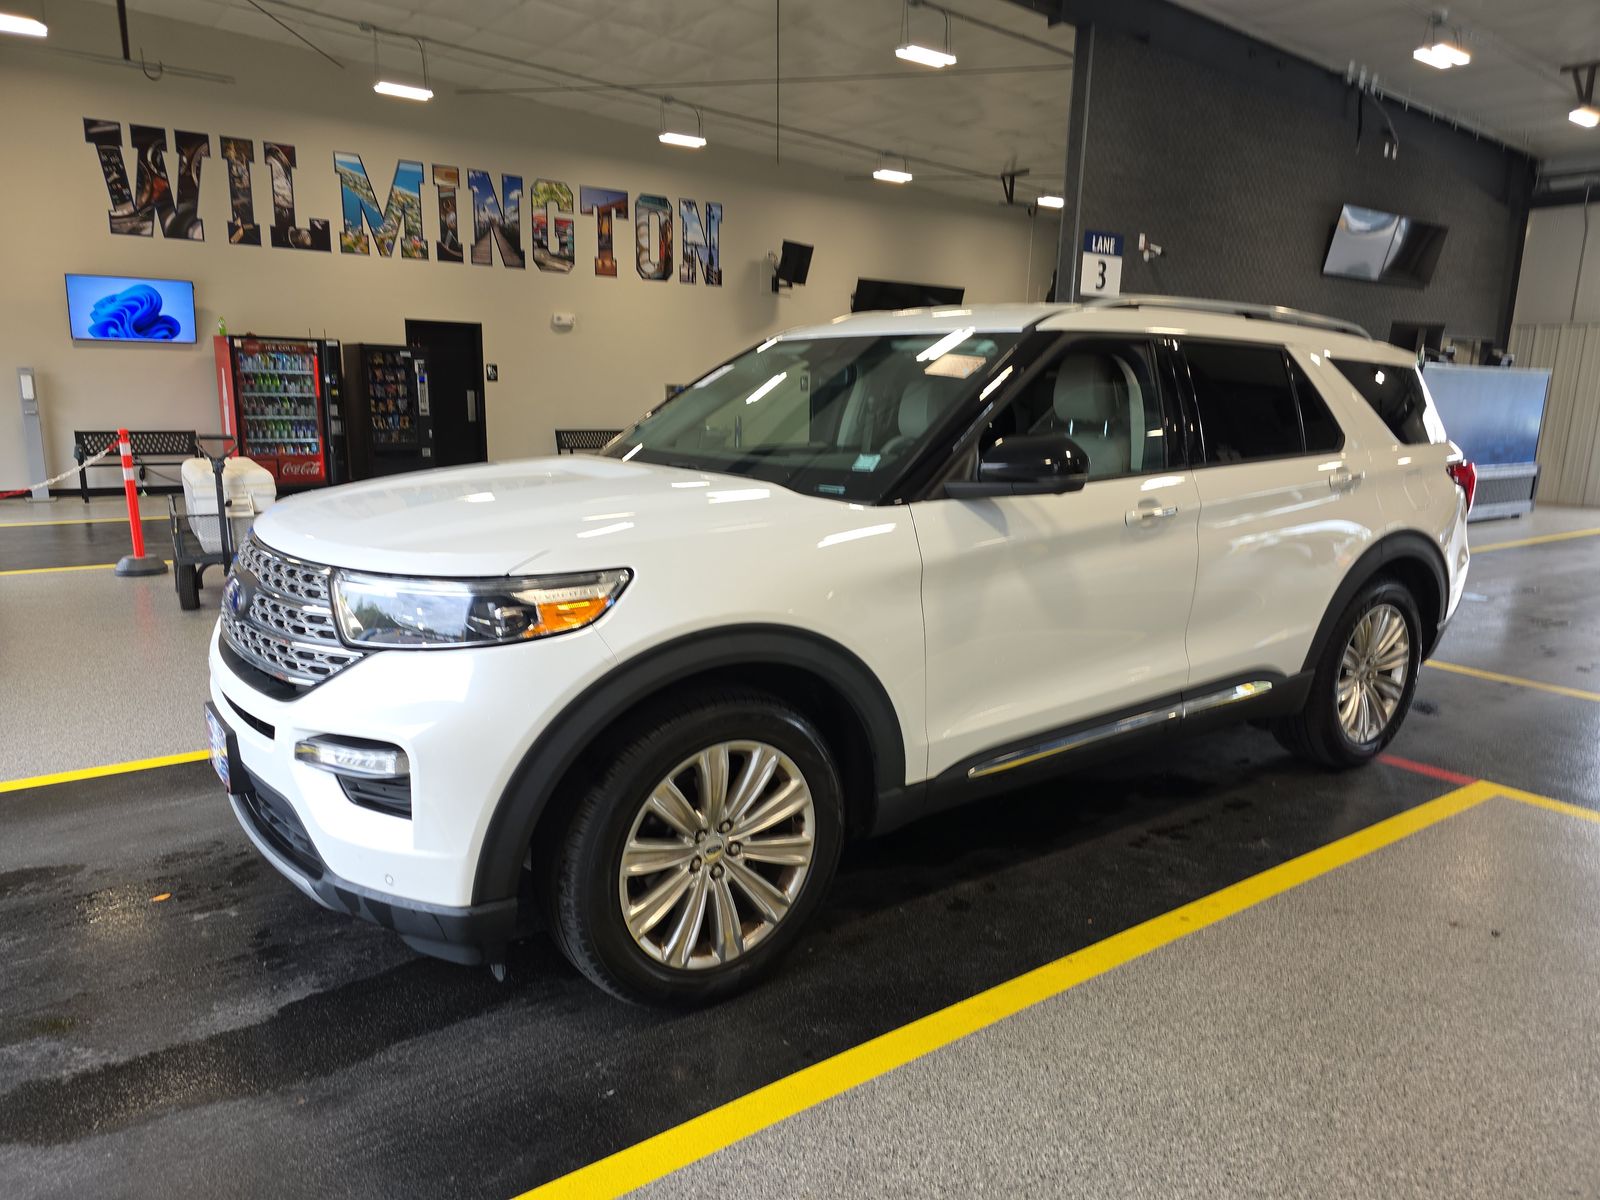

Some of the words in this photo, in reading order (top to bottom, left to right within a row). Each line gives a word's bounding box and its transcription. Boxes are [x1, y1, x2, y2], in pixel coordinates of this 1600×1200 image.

[83, 117, 723, 287] WILMINGTON
[1092, 235, 1116, 255] LANE
[1096, 260, 1107, 290] 3
